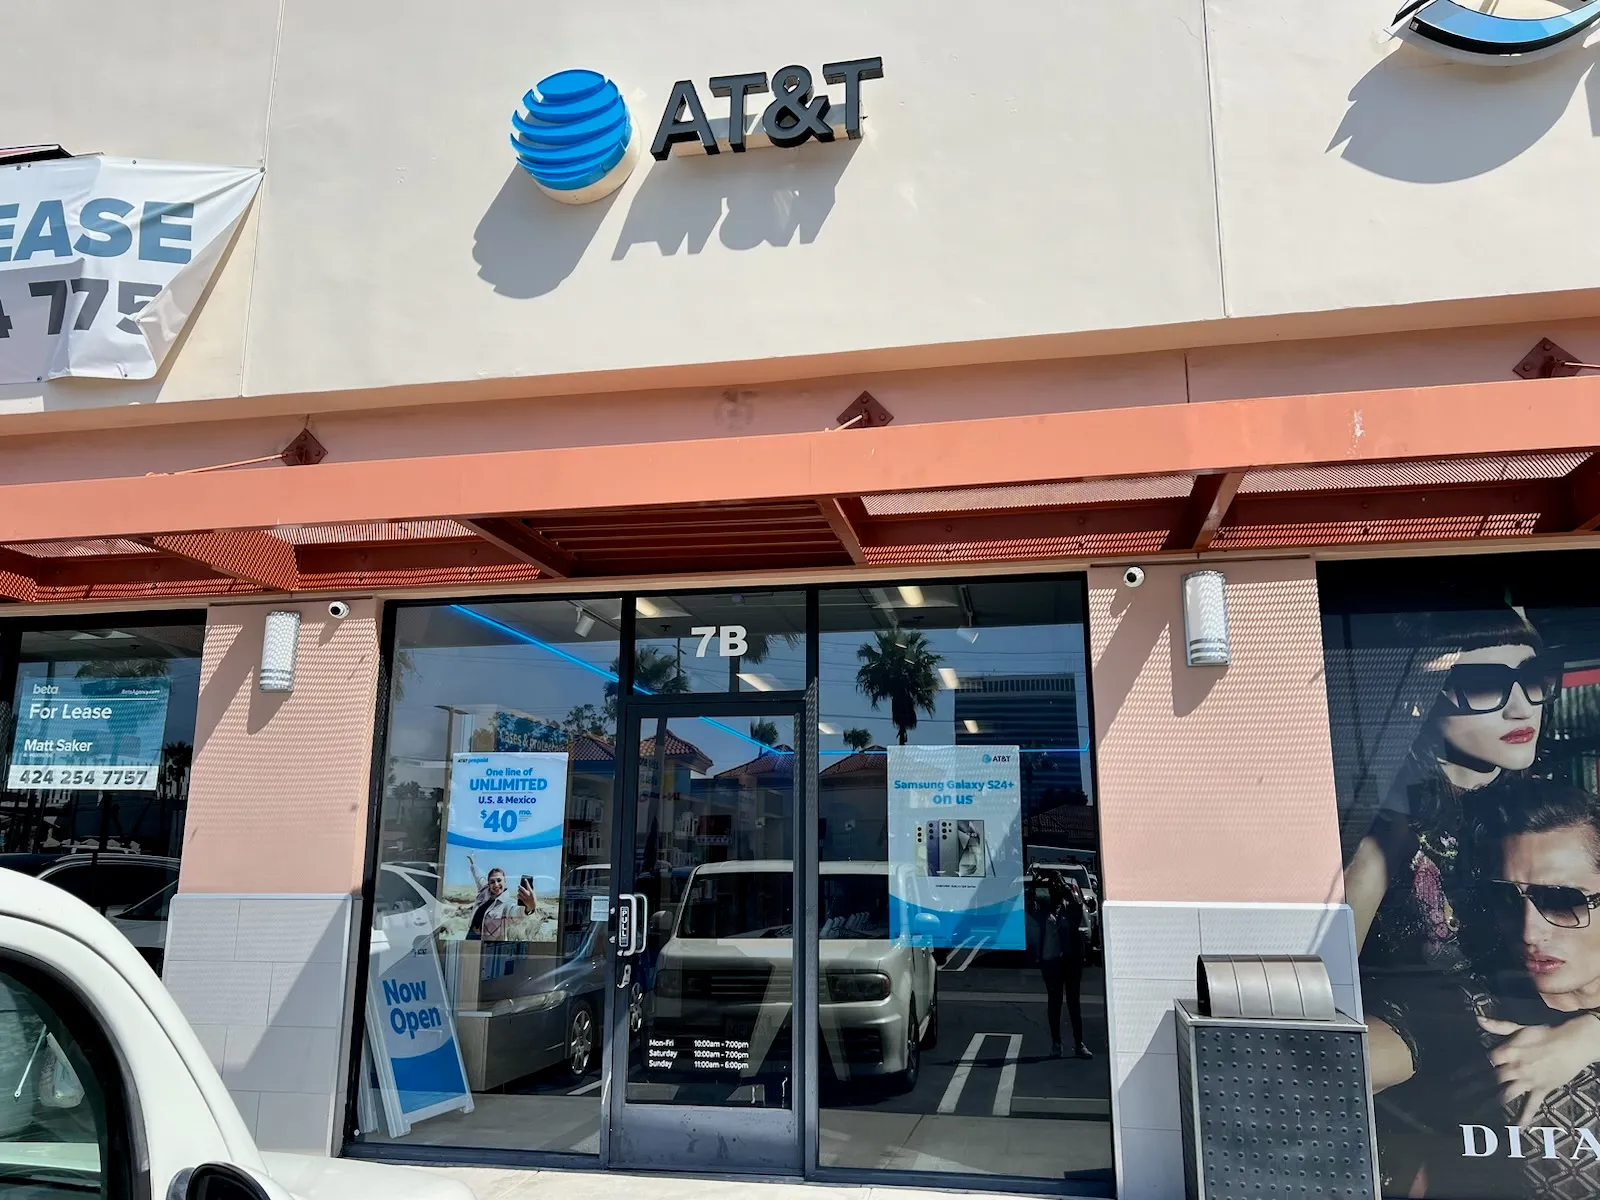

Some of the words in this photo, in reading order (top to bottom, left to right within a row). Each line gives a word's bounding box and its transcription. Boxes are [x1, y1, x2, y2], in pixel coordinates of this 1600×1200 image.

[650, 56, 883, 161] AT&T
[28, 277, 163, 336] 775
[691, 625, 748, 658] 7B
[29, 703, 58, 720] For
[62, 703, 112, 720] Lease
[24, 738, 54, 752] Matt
[56, 739, 93, 752] Saker
[992, 755, 1010, 763] AT&T
[19, 770, 54, 785] 424
[60, 770, 95, 785] 254
[102, 770, 148, 785] 7757
[486, 768, 504, 776] One
[505, 768, 521, 776] line
[523, 767, 533, 776] of
[469, 778, 548, 791] UNLIMITED
[894, 780, 944, 791] Samsung
[948, 780, 984, 791] Galaxy
[987, 780, 1015, 790] S24+
[478, 796, 495, 804] U.S.
[496, 796, 504, 804] &
[505, 796, 537, 804] Mexico
[932, 794, 951, 805] on
[956, 794, 974, 805] us
[480, 809, 518, 833] $40
[382, 979, 427, 1006] Now
[390, 1006, 441, 1040] Open
[649, 1039, 674, 1047] Mon-Fri
[694, 1040, 720, 1048] 10:00am
[725, 1041, 749, 1050] 7:00pm
[649, 1050, 678, 1059] Saturday
[694, 1051, 720, 1059] 10:00am
[725, 1051, 749, 1060] 7:00pm
[649, 1060, 673, 1069] Sunday
[694, 1061, 720, 1069] 11:00am
[725, 1061, 749, 1071] 6:00pm
[1459, 1124, 1600, 1161] DITA
